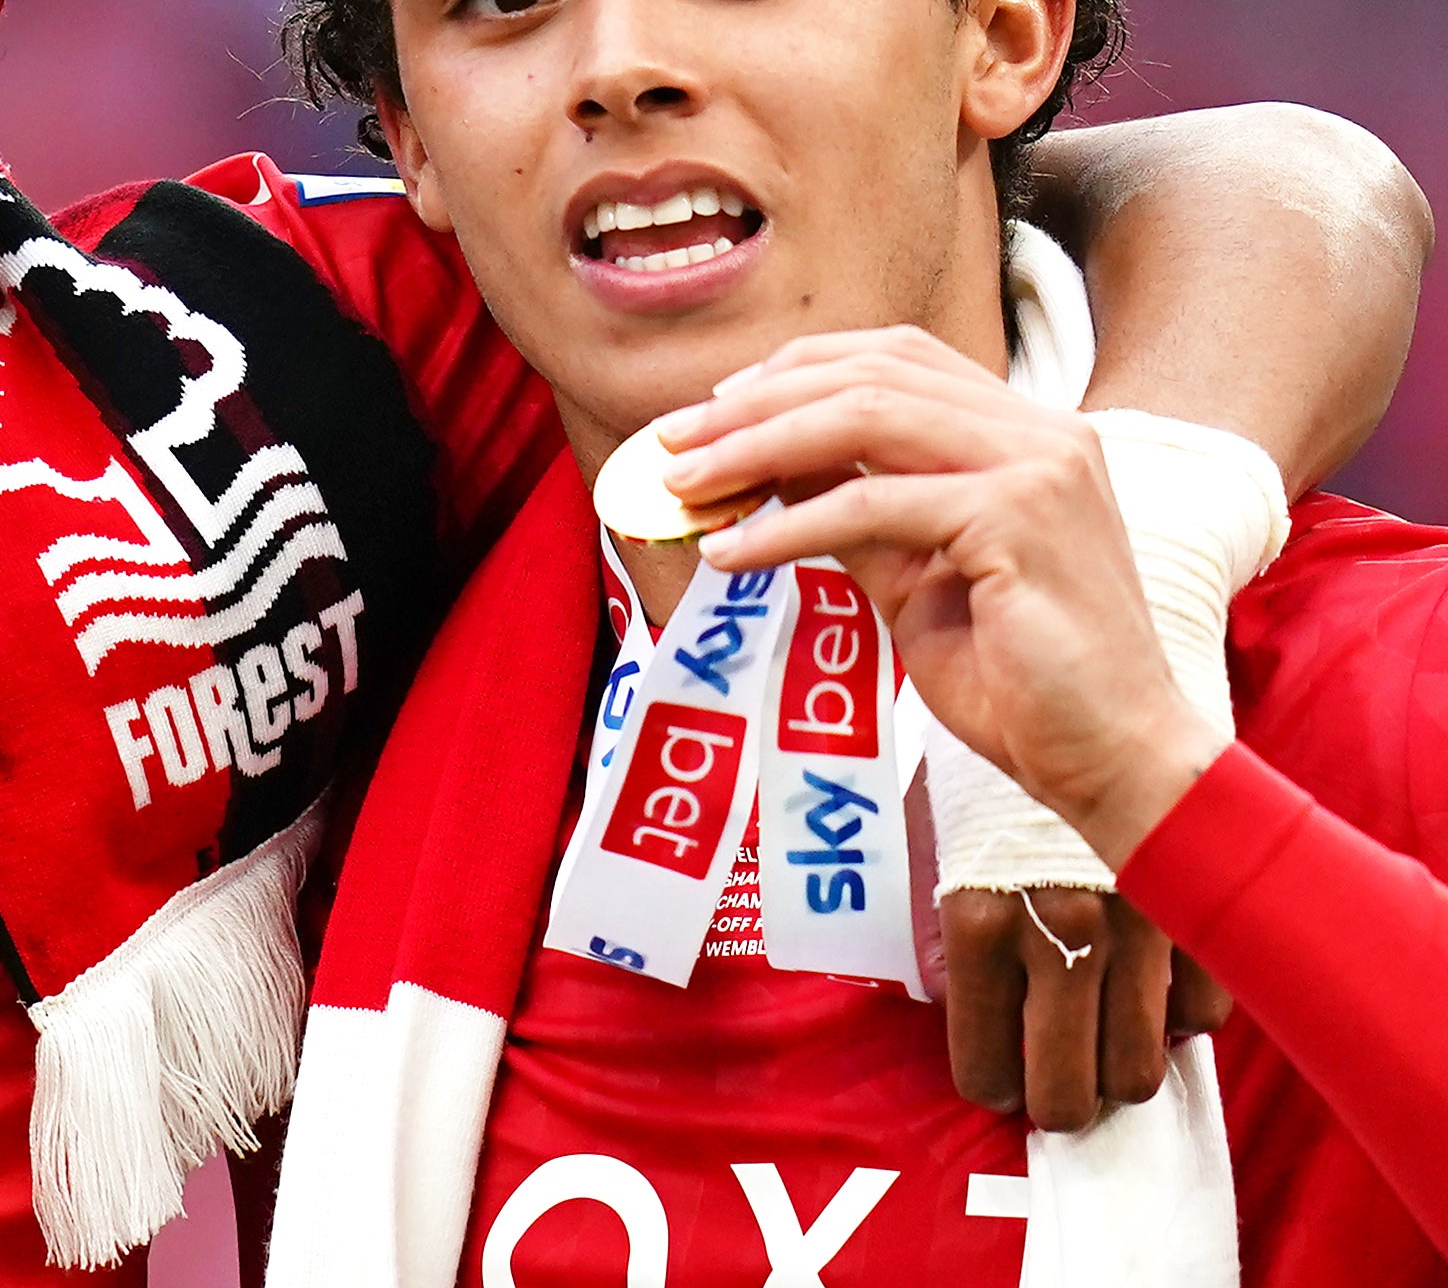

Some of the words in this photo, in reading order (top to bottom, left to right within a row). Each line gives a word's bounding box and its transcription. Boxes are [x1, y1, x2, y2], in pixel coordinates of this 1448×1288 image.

[673, 565, 778, 698] sky
[788, 585, 861, 737] bet
[632, 725, 734, 859] bet
[786, 768, 880, 914] sky
